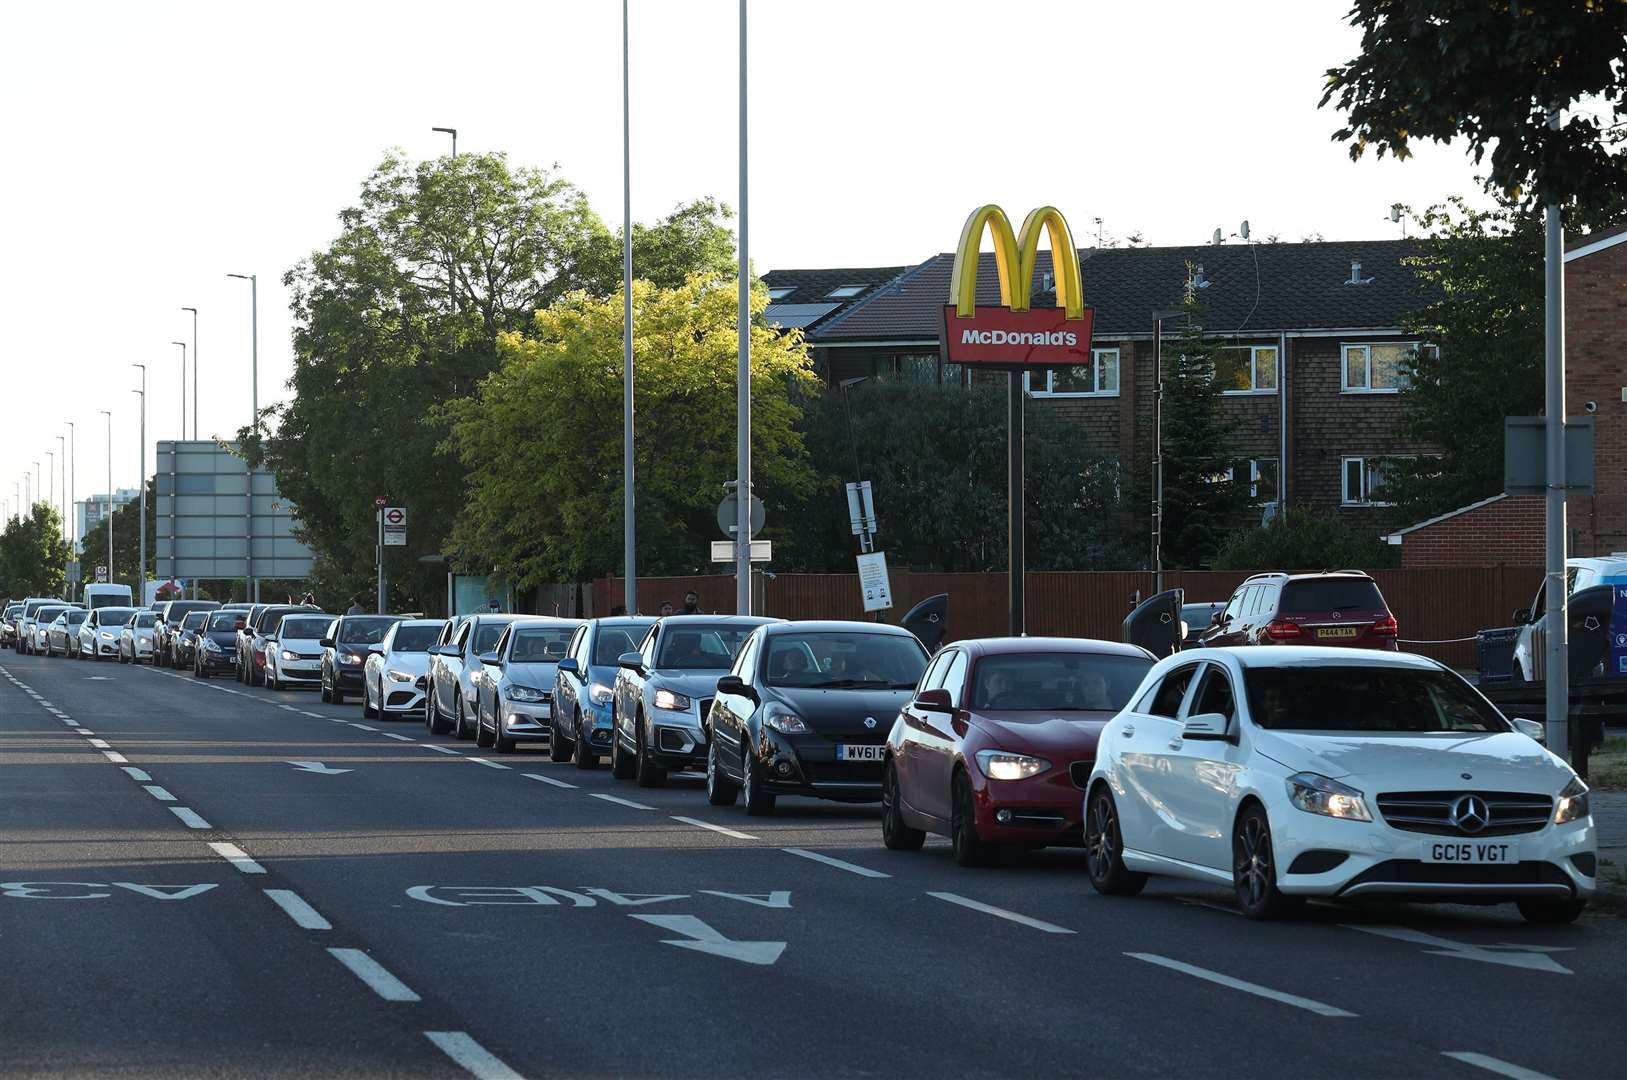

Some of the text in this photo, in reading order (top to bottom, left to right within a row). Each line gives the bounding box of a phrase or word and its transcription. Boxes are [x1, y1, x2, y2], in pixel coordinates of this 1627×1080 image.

[961, 329, 1077, 346] McDonald's
[1432, 843, 1508, 861] GC15 VGT
